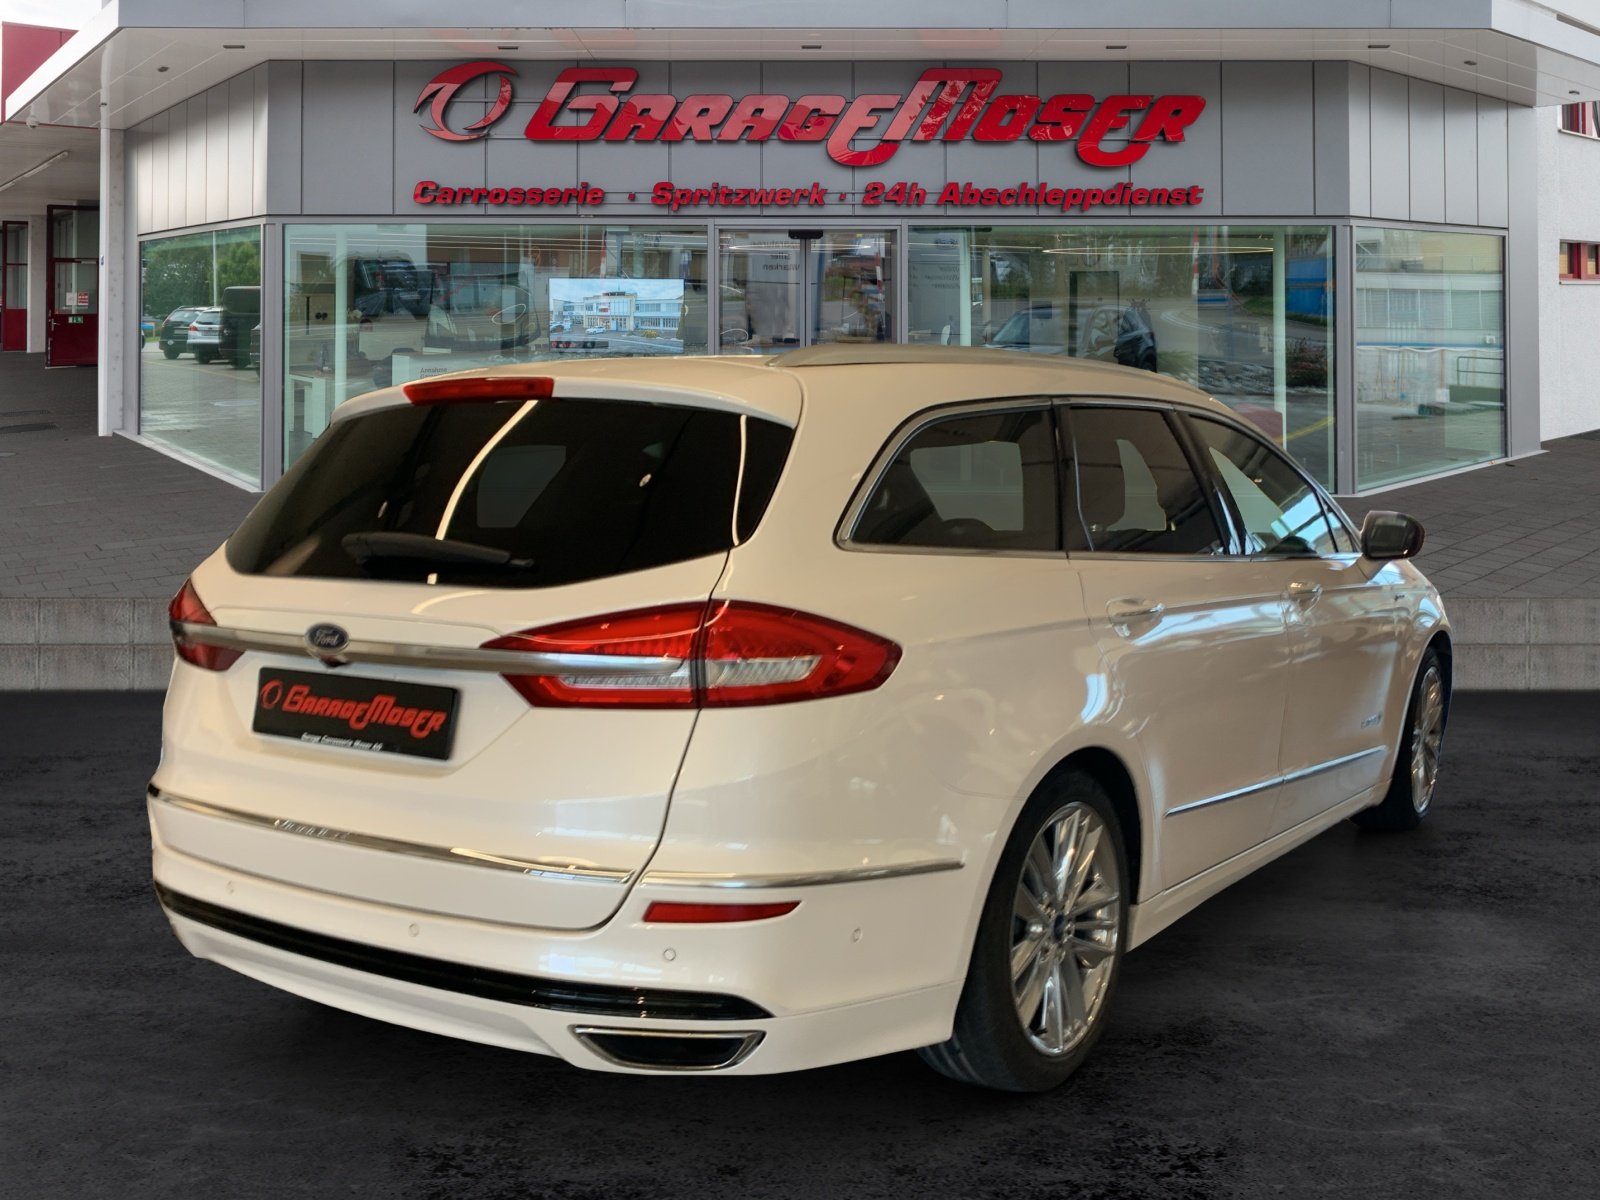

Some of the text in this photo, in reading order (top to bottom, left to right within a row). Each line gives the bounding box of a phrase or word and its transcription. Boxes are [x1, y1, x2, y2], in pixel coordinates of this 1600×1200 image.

[413, 181, 1204, 212] Carrosserie Spritzwerk 24h Abschleppdienst
[314, 629, 340, 647] Ford
